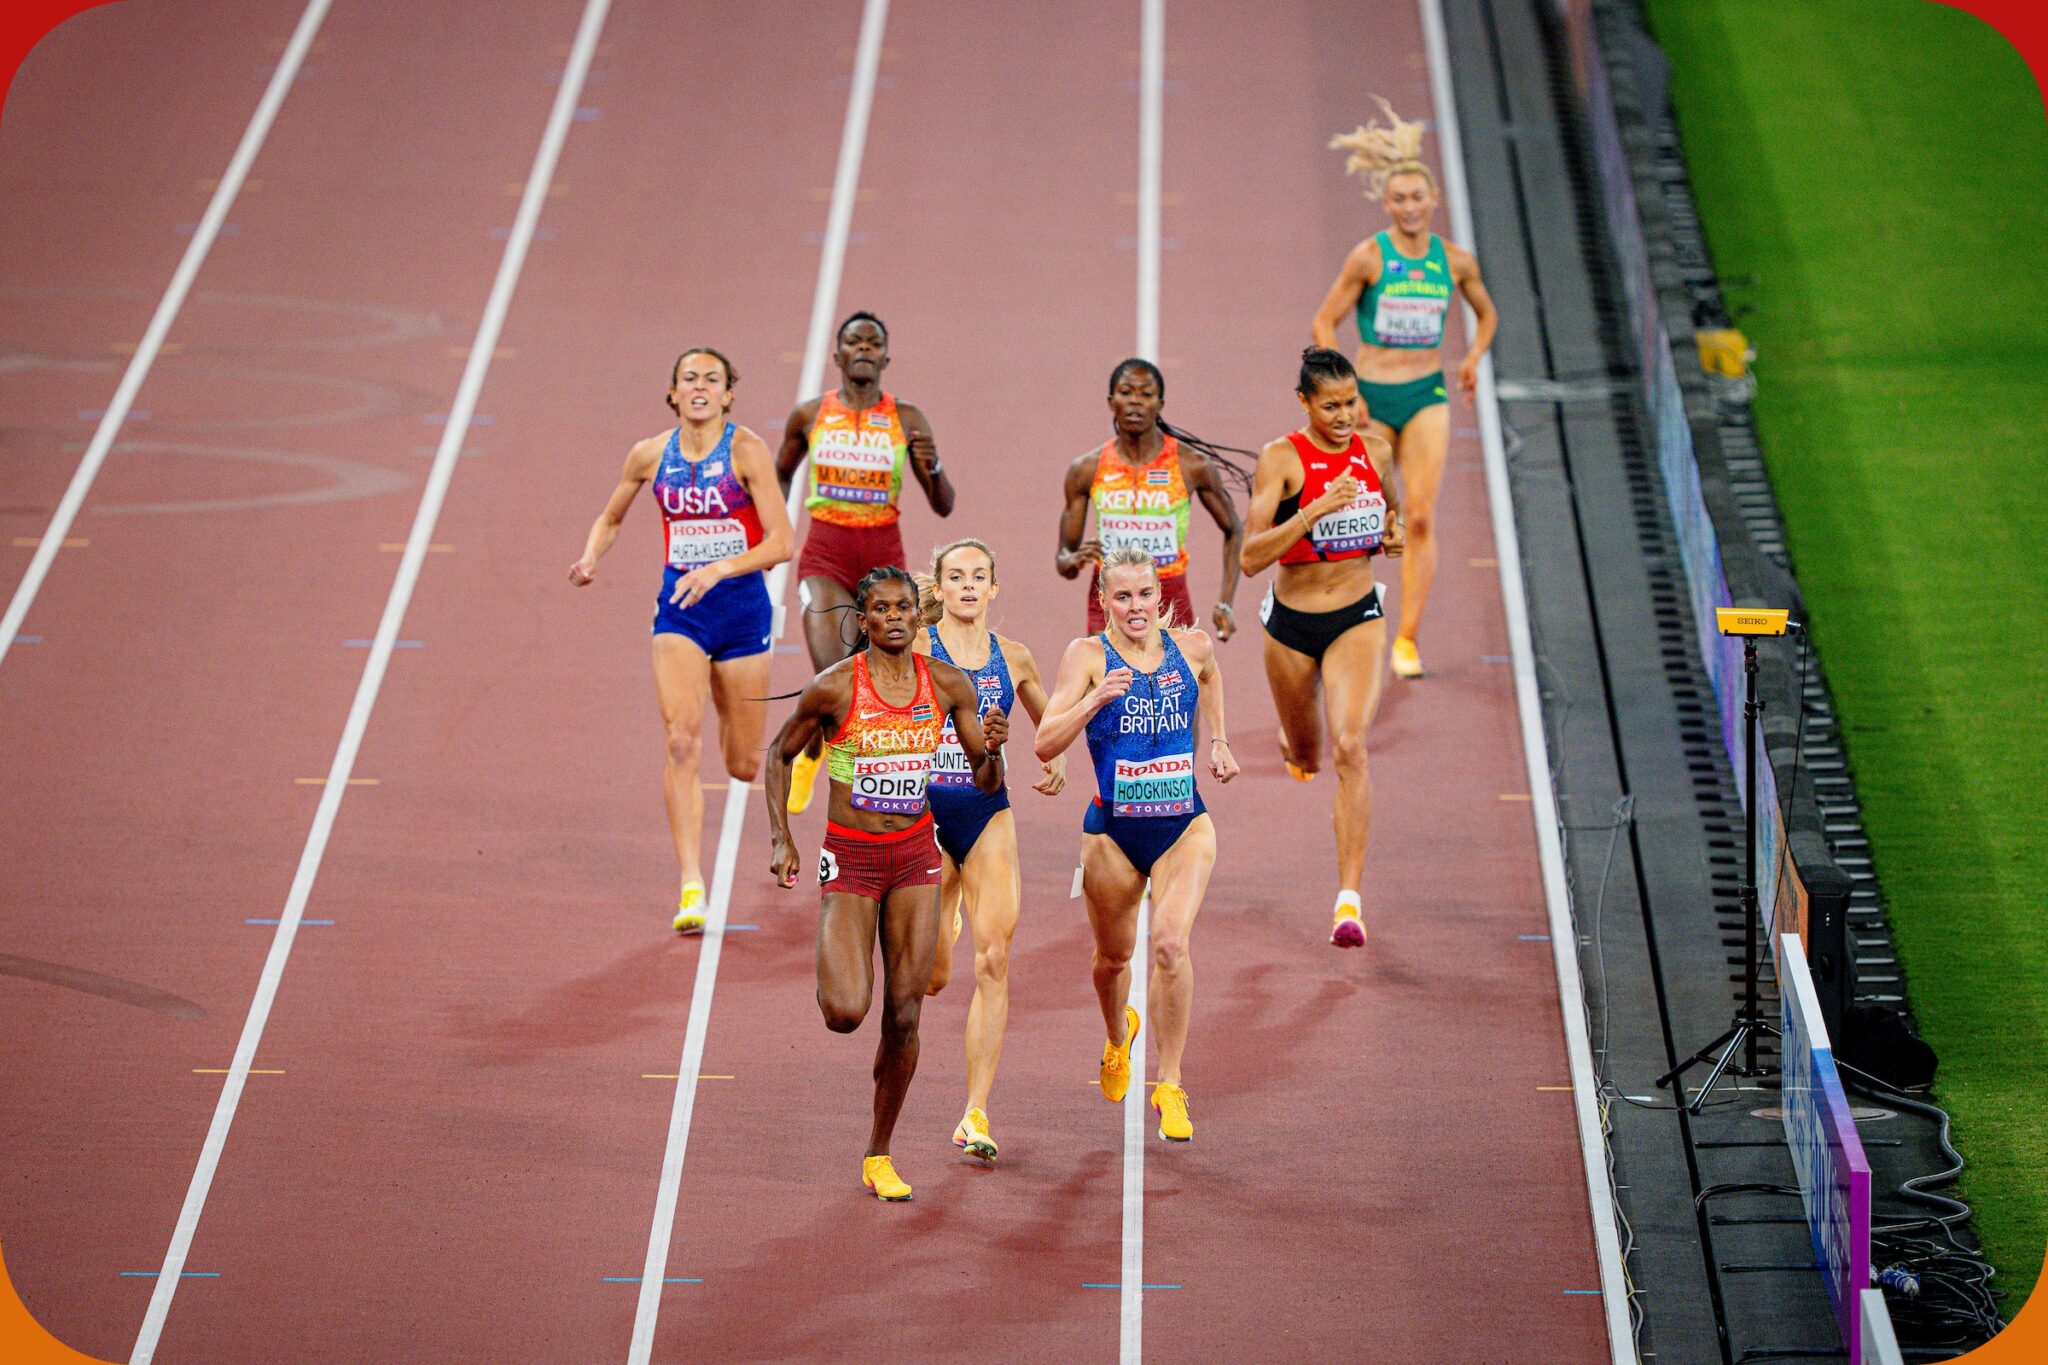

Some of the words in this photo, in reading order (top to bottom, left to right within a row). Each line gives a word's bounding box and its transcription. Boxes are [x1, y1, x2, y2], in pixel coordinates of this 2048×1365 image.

[823, 430, 891, 447] KENYA
[818, 450, 891, 465] HONDA
[663, 486, 728, 514] USA
[1100, 489, 1170, 509] KENYA
[673, 524, 741, 536] HONDA
[1102, 519, 1172, 531] HONDA
[1319, 514, 1379, 536] WERRO
[1125, 693, 1181, 715] GREAT
[1120, 712, 1188, 734] BRITAIN
[862, 727, 935, 749] KENYA
[856, 759, 931, 774] HONDA
[932, 752, 969, 769] HUNTE
[1118, 759, 1191, 777] HONDA
